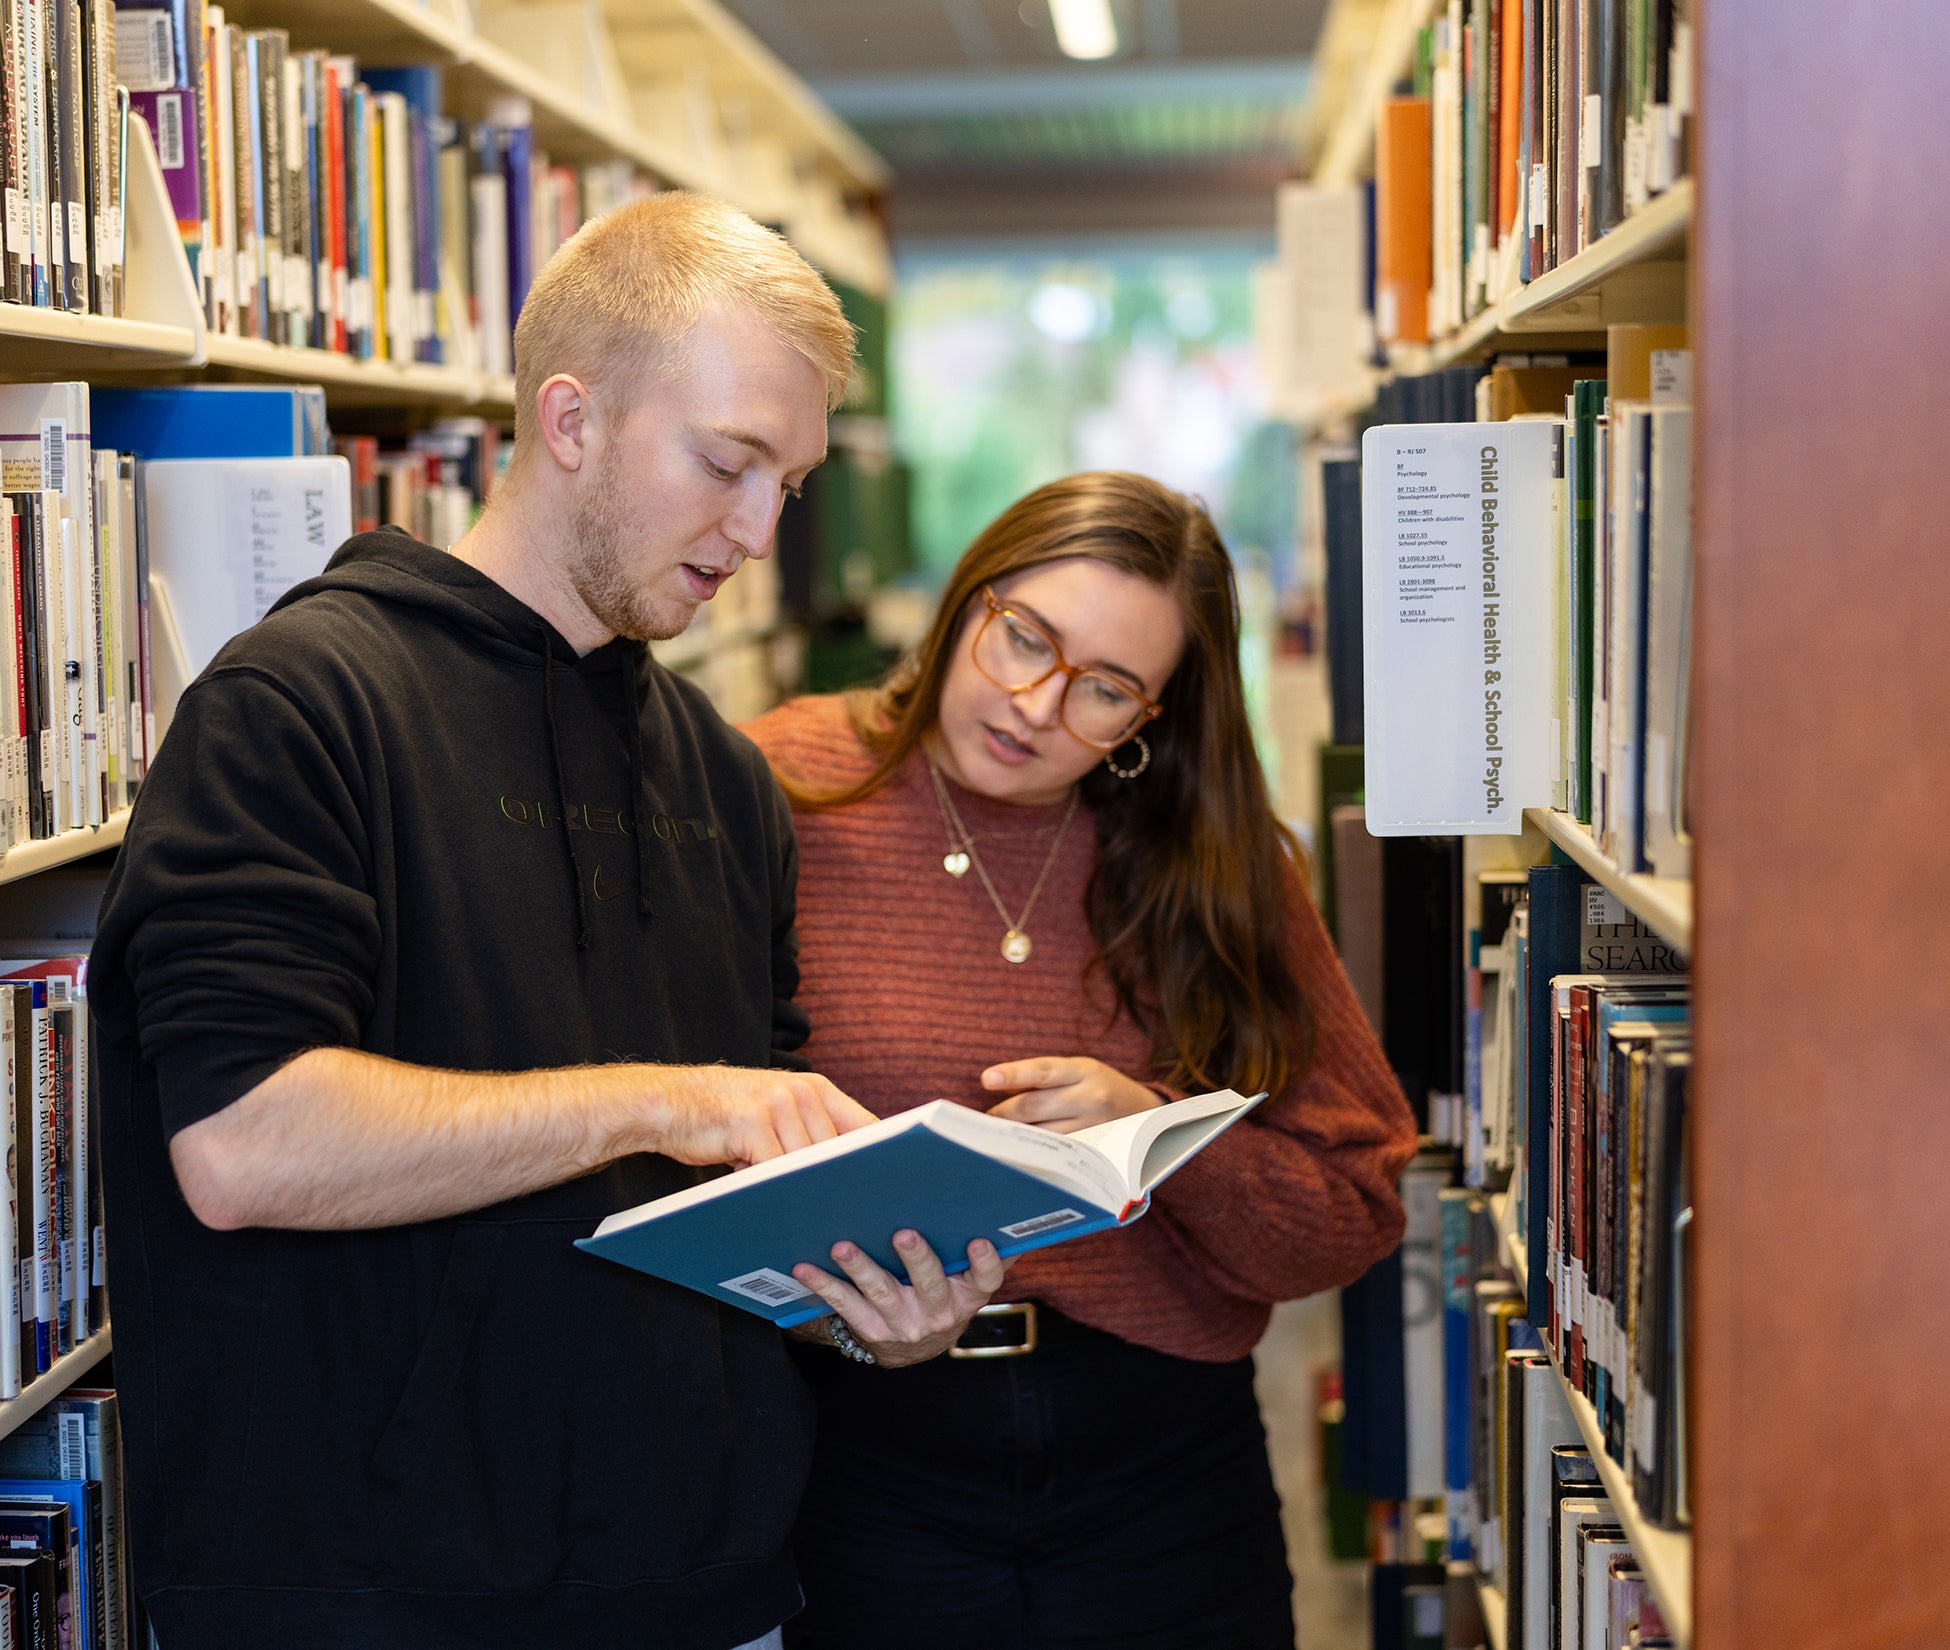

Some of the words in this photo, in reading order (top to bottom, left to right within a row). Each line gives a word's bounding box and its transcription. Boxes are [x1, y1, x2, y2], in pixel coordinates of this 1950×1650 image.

[17, 0, 26, 104] EMOCRACY
[30, 9, 38, 57] FIXING
[48, 0, 57, 64] HETORIC
[49, 69, 58, 81] &
[52, 86, 61, 184] DEMOCRACY
[72, 93, 80, 168] NATIONS
[1480, 445, 1498, 493] Child
[305, 489, 325, 547] LAW
[1481, 499, 1500, 598] Behavioral
[94, 565, 103, 624] UNDER
[1483, 604, 1501, 664] Health
[1484, 670, 1501, 685] &
[1484, 690, 1503, 751] School
[1483, 757, 1504, 814] Psych.
[1586, 945, 1692, 972] SEARC
[39, 1016, 48, 1086] PATRICK
[38, 1092, 48, 1104] J.
[40, 1110, 50, 1195] BUCHANAN
[37, 1220, 47, 1252] WENT
[22, 1533, 40, 1542] laugh
[106, 1515, 115, 1537] OF
[107, 1540, 117, 1575] THE
[1609, 1552, 1633, 1560] FROM
[32, 1592, 40, 1618] One
[108, 1579, 119, 1641] UNITED
[33, 1619, 41, 1650] Orde
